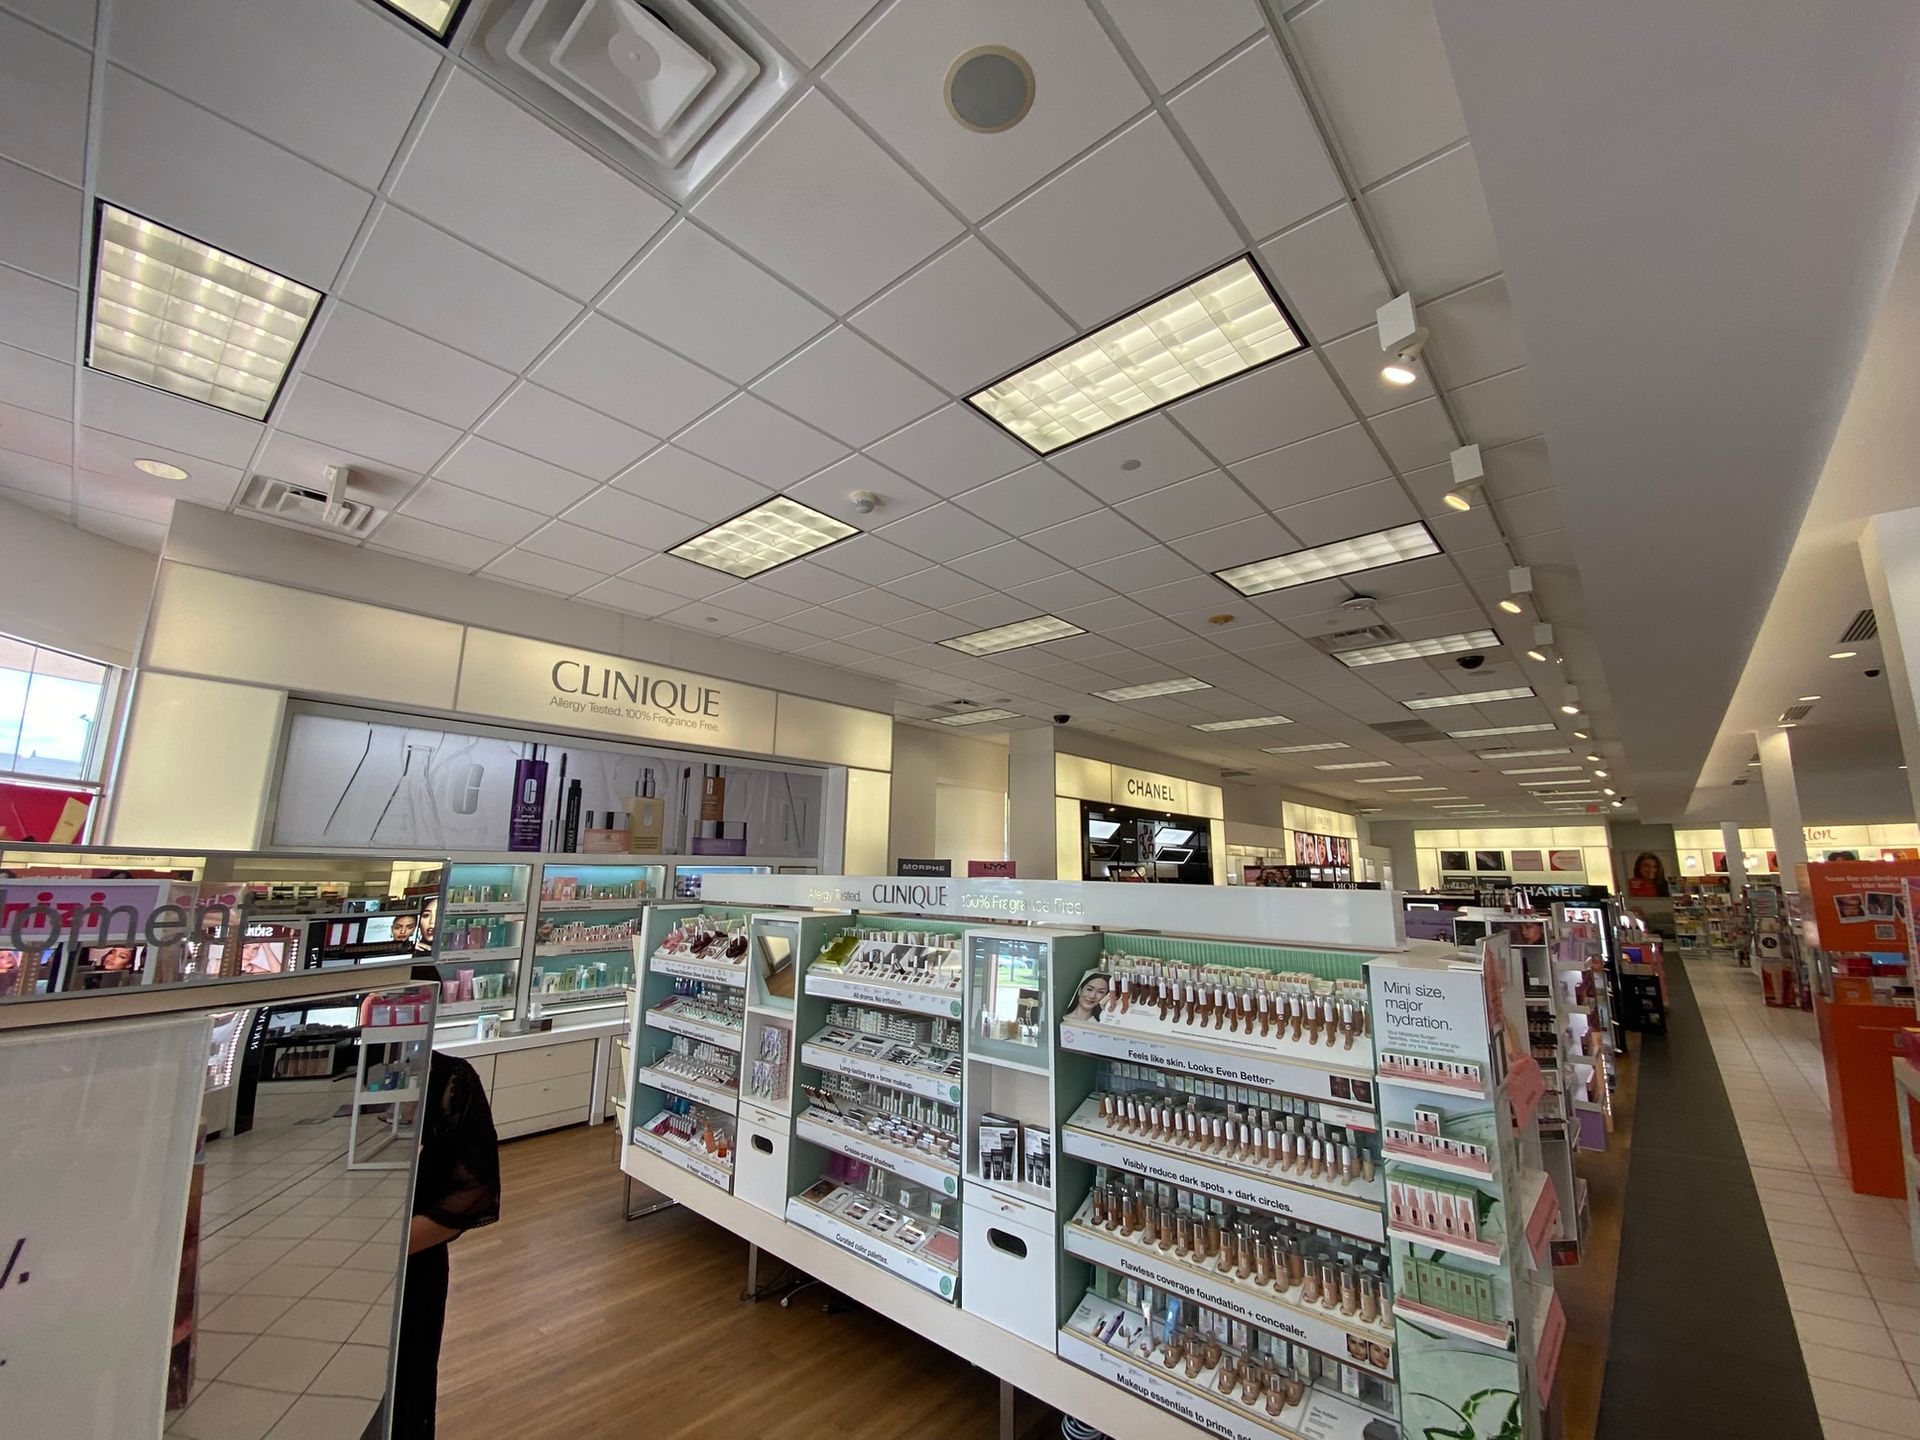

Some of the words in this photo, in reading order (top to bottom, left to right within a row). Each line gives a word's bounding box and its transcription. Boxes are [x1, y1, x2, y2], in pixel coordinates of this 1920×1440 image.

[552, 660, 721, 717] CLINIQUE
[549, 696, 587, 713] Allergy
[590, 701, 624, 717] Tested.
[626, 708, 652, 721] 100%
[652, 712, 697, 729] Fragrance
[700, 720, 720, 732] Free.
[1127, 779, 1175, 802] CHANEL
[1803, 828, 1838, 841] lon
[902, 863, 945, 872] MORPHE
[808, 888, 833, 903] Allergy
[872, 884, 946, 908] CLINIQUE
[1512, 886, 1582, 898] CHANEL
[0, 887, 258, 953] oment
[1384, 980, 1411, 995] Mini
[1415, 984, 1446, 1000] size,
[1385, 998, 1424, 1013] major
[1386, 1011, 1452, 1031] hydration.
[840, 1064, 866, 1078] Long-lasting
[880, 1074, 892, 1082] brow
[1128, 1050, 1149, 1061] Feels
[1150, 1054, 1164, 1064] like
[1166, 1057, 1186, 1068] skin.
[1188, 1061, 1214, 1074] Looks
[1216, 1067, 1238, 1079] Even
[844, 1145, 873, 1161] Crease-proof
[874, 1157, 896, 1170] shadows.
[1122, 1158, 1148, 1172] Visibly
[1150, 1166, 1178, 1180] reduce
[1179, 1174, 1199, 1186] dark
[1201, 1180, 1225, 1194] spots
[1236, 1191, 1257, 1203] dark
[1258, 1197, 1293, 1213] circles.
[836, 1233, 855, 1248] Curated
[855, 1243, 867, 1253] color
[867, 1249, 888, 1264] palettes.
[1120, 1259, 1155, 1278] Flawless
[1156, 1274, 1195, 1295] coverage
[1197, 1290, 1246, 1315] foundation
[1255, 1313, 1307, 1339] concealer.
[1116, 1373, 1149, 1396] Makeup
[1150, 1390, 1194, 1418] essentials
[1195, 1412, 1204, 1423] to
[1206, 1418, 1236, 1440] prime,
